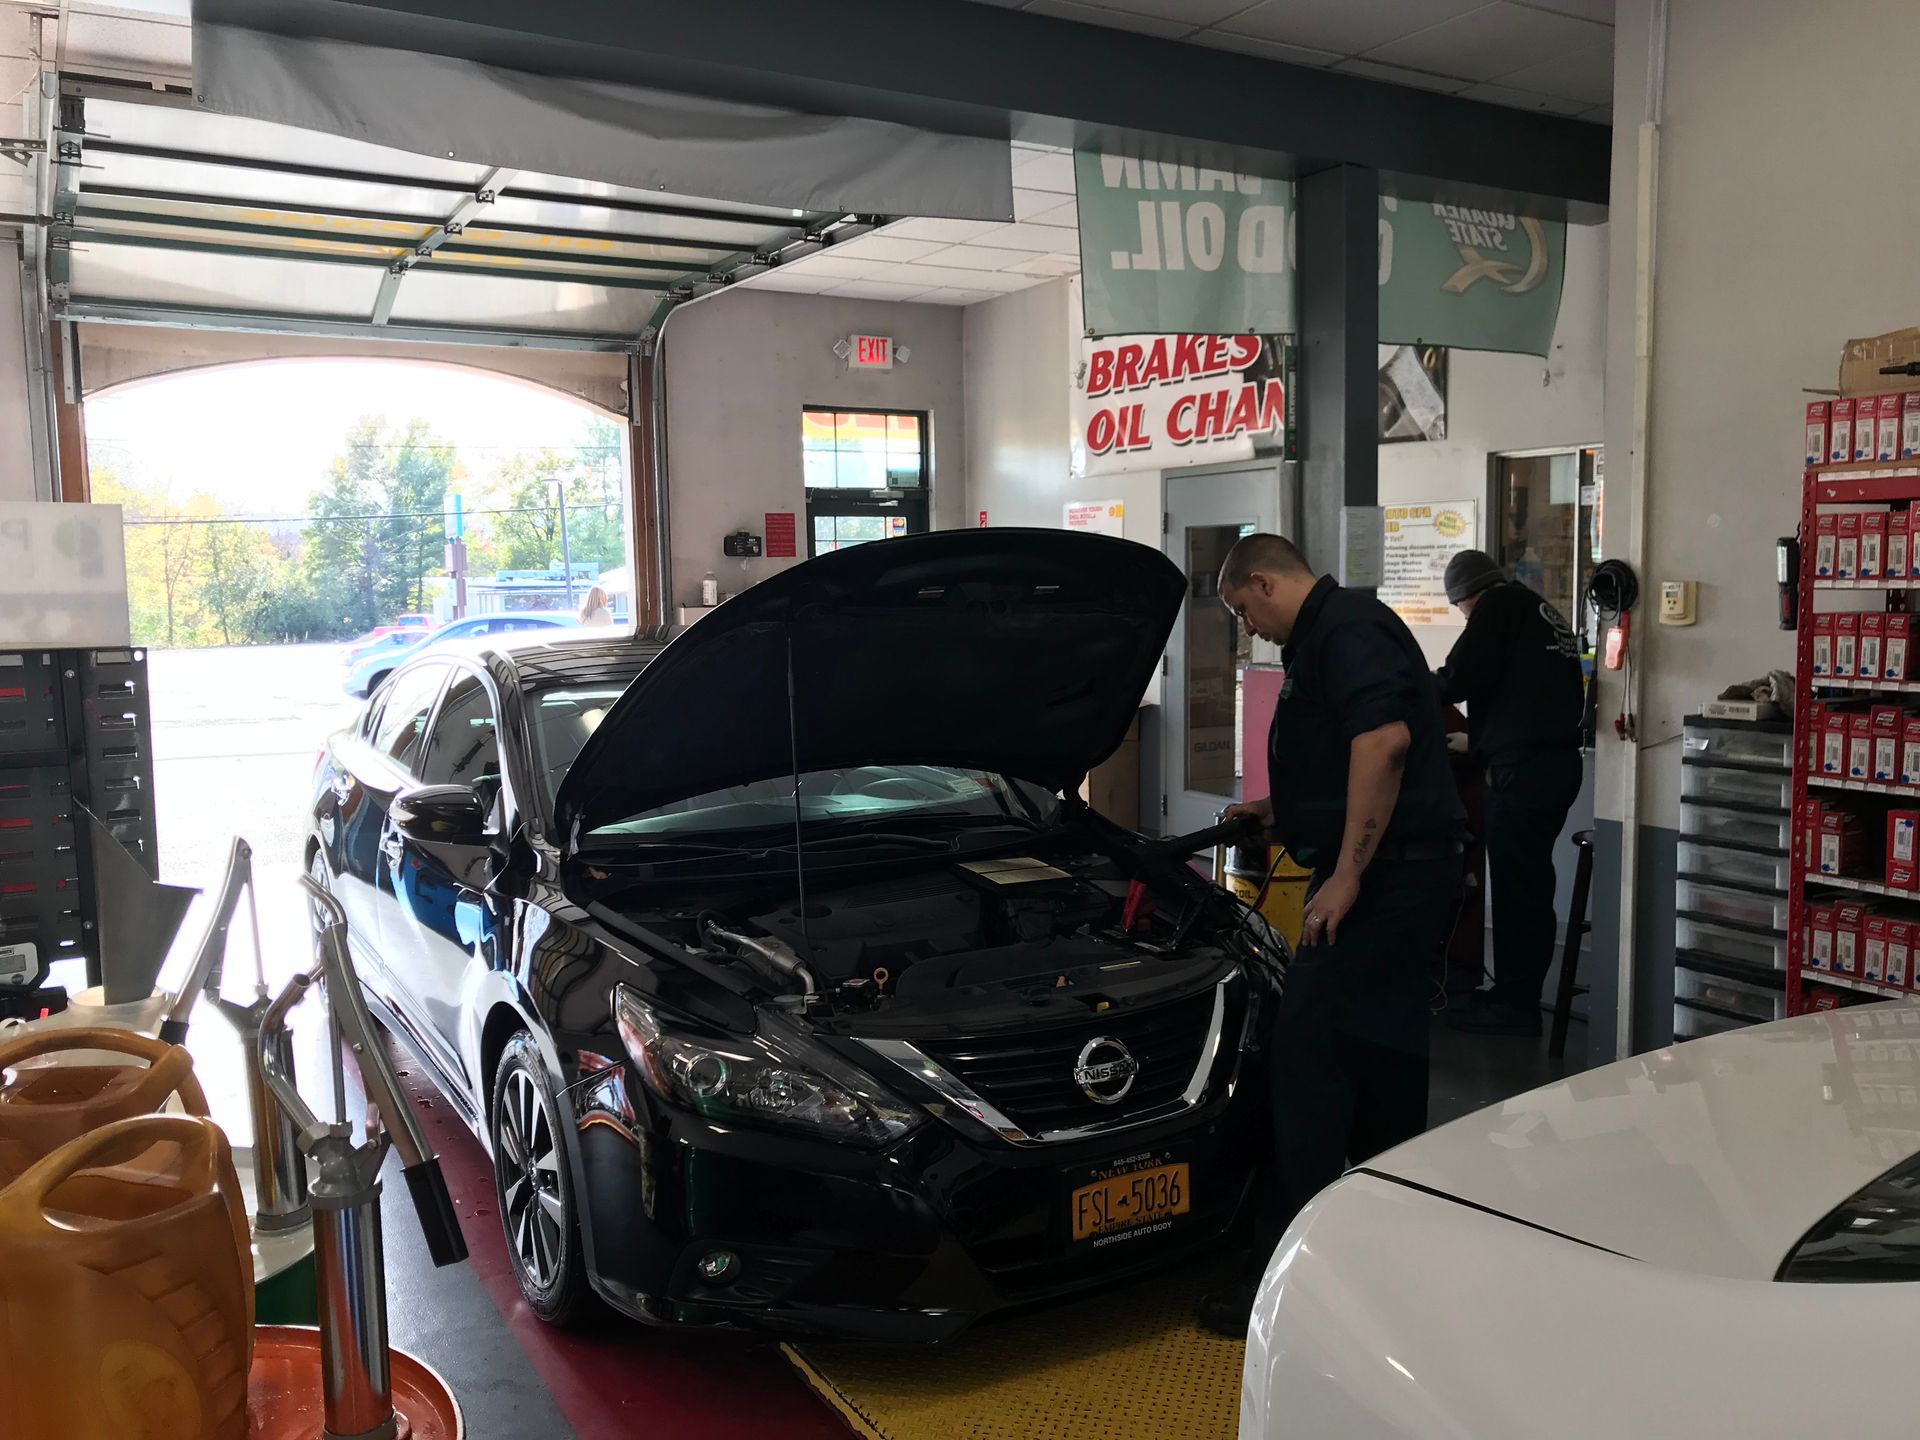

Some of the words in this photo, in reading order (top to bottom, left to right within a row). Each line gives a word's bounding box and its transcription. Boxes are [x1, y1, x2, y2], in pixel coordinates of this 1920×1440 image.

[858, 337, 888, 363] EXIT
[1086, 335, 1261, 397] BRAKES
[1087, 403, 1151, 454] OIL
[1083, 1060, 1135, 1081] NISSAN
[1078, 1187, 1116, 1232] FSL
[1131, 1171, 1181, 1216] 5036
[1093, 1230, 1132, 1248] NORTHSIDE
[1133, 1226, 1152, 1239] AUTO
[1153, 1221, 1176, 1233] BODY
